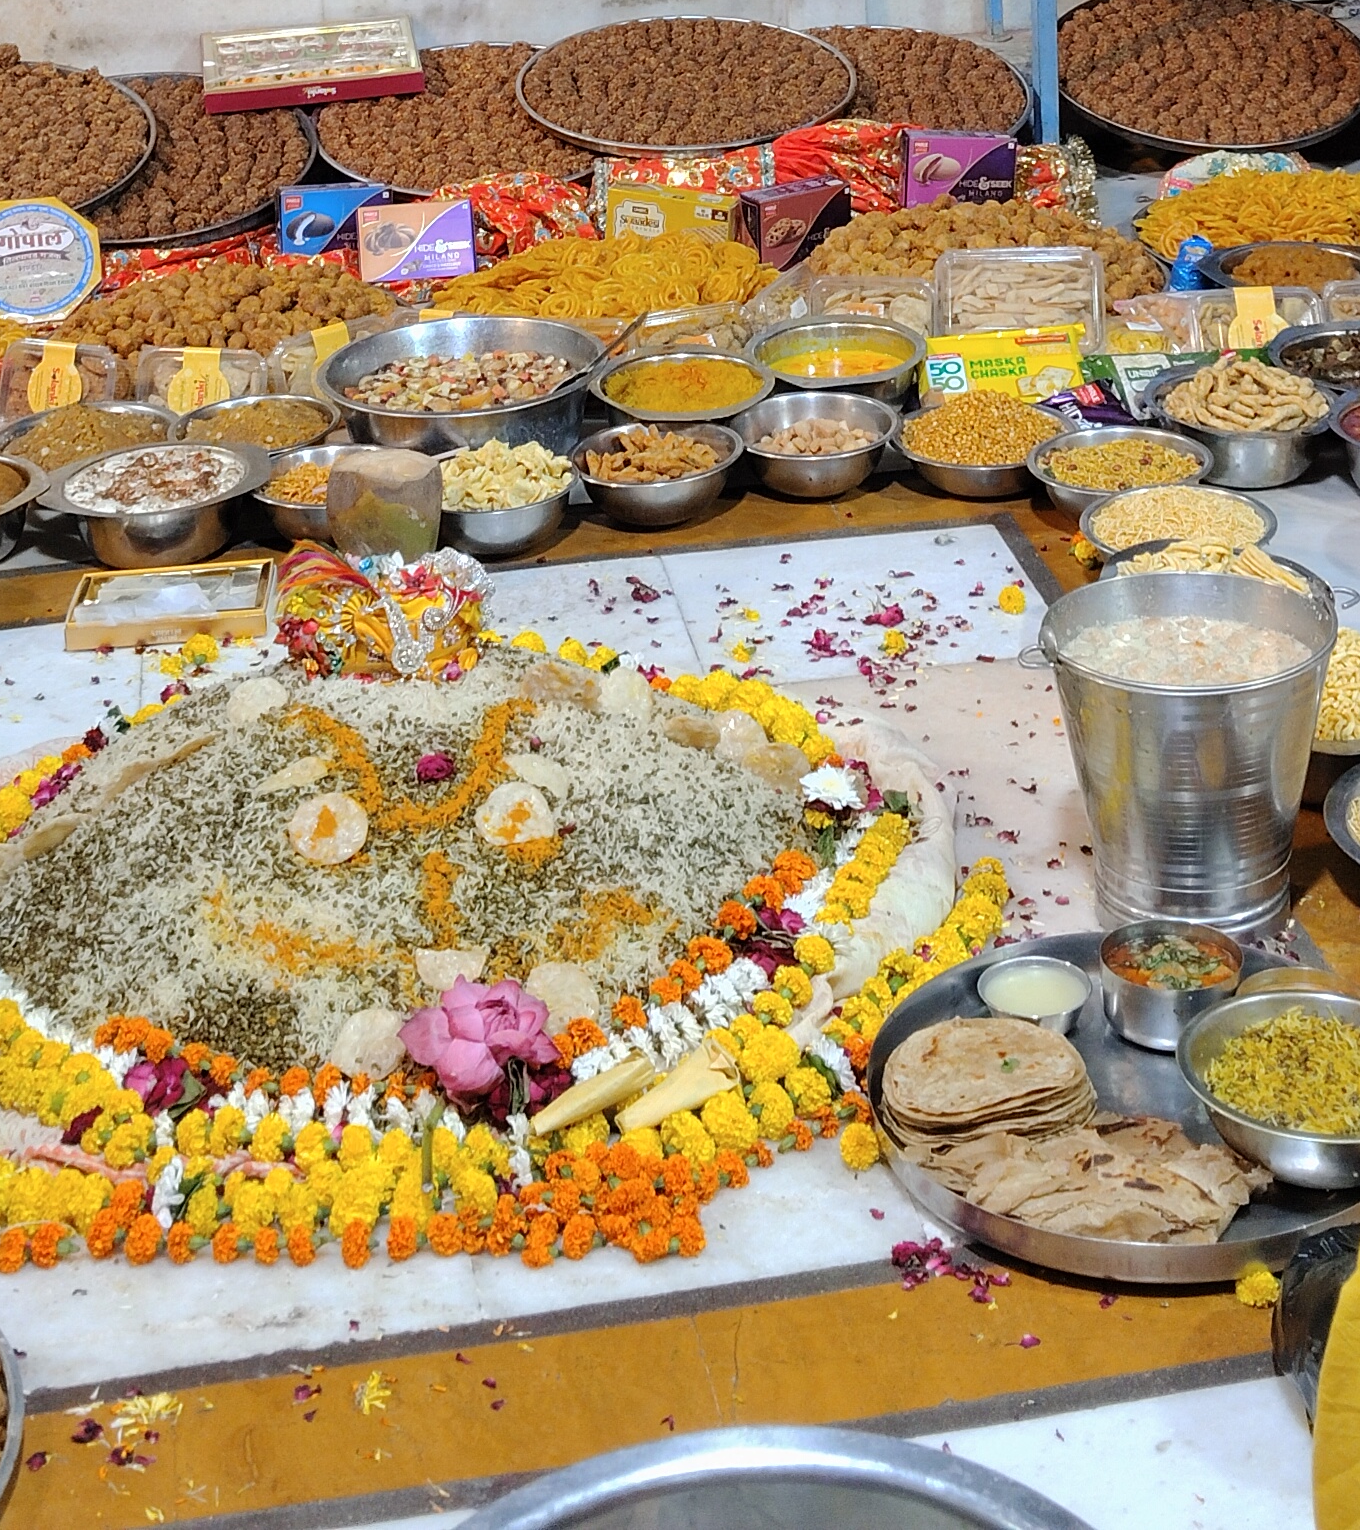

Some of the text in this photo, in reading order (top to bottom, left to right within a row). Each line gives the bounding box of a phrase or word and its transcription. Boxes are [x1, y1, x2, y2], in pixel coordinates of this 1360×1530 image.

[424, 252, 460, 261] MILANO
[929, 361, 961, 376] 50
[969, 356, 1026, 369] MASKA
[970, 366, 1028, 380] CHASKA
[932, 376, 965, 390] 50
